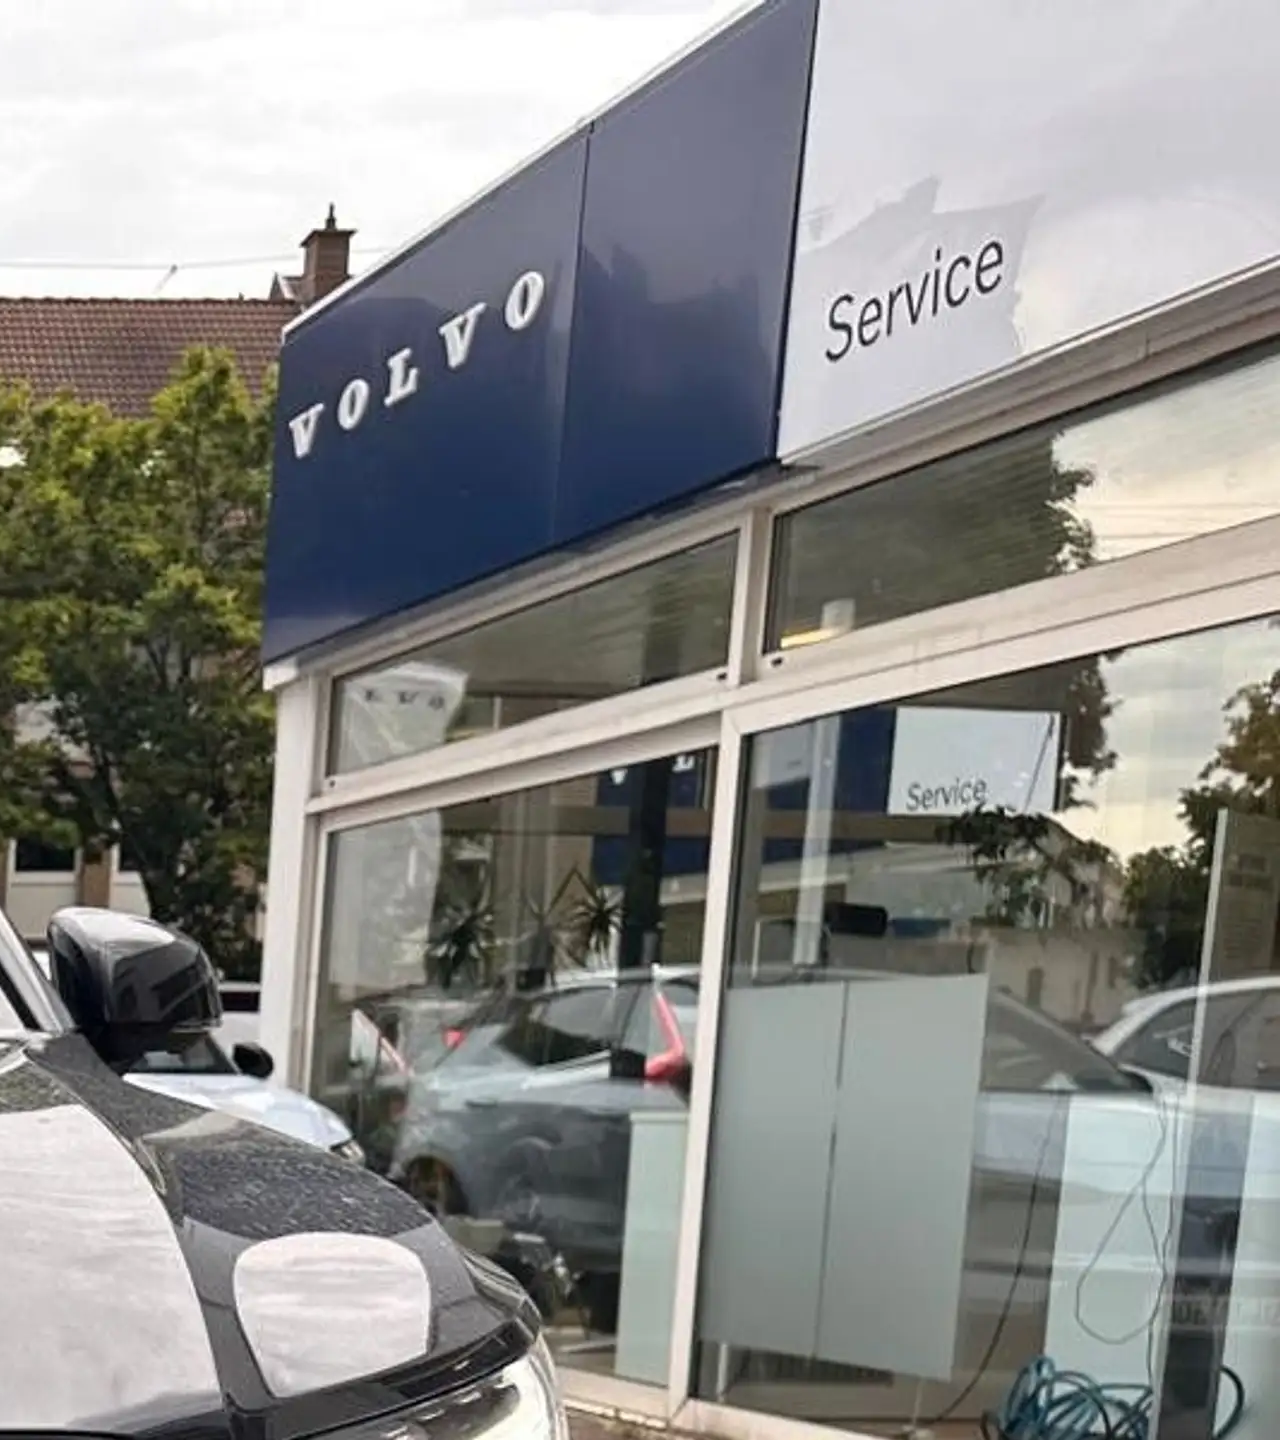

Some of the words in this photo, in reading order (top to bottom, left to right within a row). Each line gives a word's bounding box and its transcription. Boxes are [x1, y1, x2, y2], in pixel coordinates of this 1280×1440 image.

[825, 240, 1003, 362] Service
[289, 270, 545, 459] VOLVO
[905, 775, 989, 811] Service
